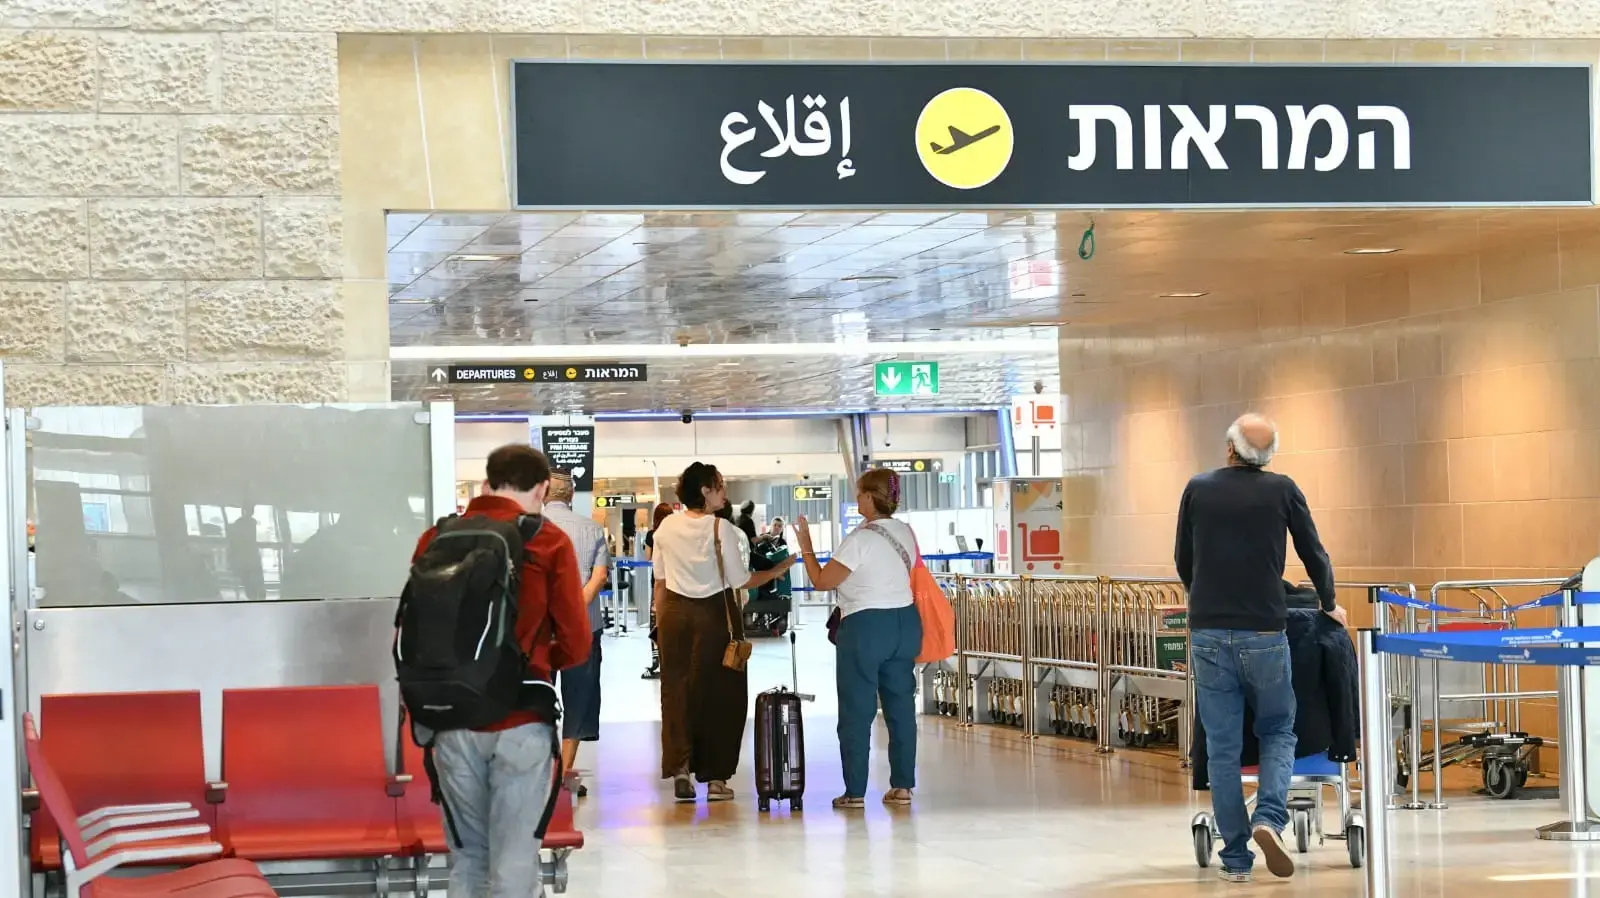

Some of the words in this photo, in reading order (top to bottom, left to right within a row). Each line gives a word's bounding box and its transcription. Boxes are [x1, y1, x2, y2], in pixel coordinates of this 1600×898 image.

[720, 94, 856, 185] إقلاع
[1068, 103, 1411, 172] המראות
[456, 369, 516, 380] DEPARTURES
[585, 367, 639, 378] המראות
